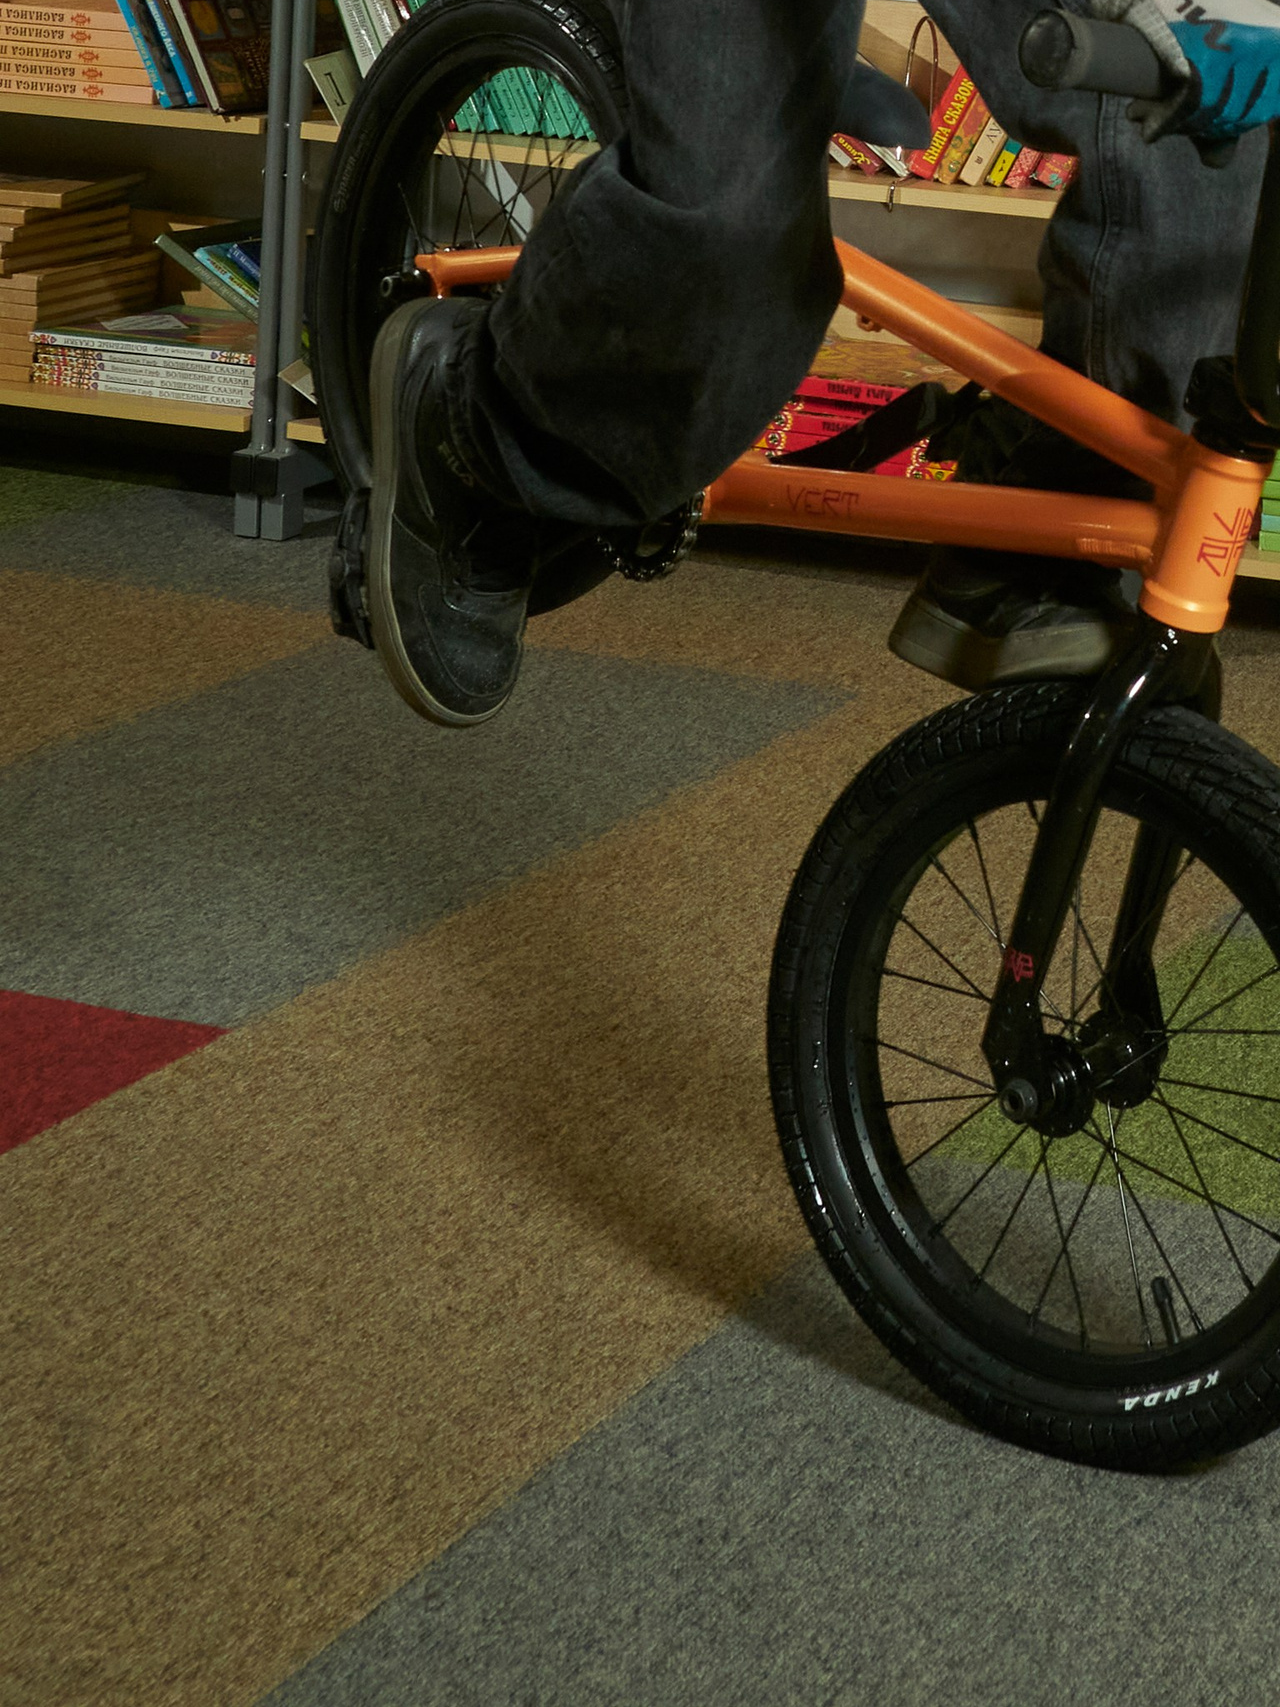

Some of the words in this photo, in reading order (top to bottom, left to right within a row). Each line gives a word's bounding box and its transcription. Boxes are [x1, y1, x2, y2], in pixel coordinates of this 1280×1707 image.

[2, 7, 65, 23] ВАСИЛИСА
[9, 44, 72, 61] ВАСИЛИСА
[922, 125, 951, 164] КНИГА
[786, 484, 859, 517] VERT
[1124, 1369, 1220, 1412] KENDA
